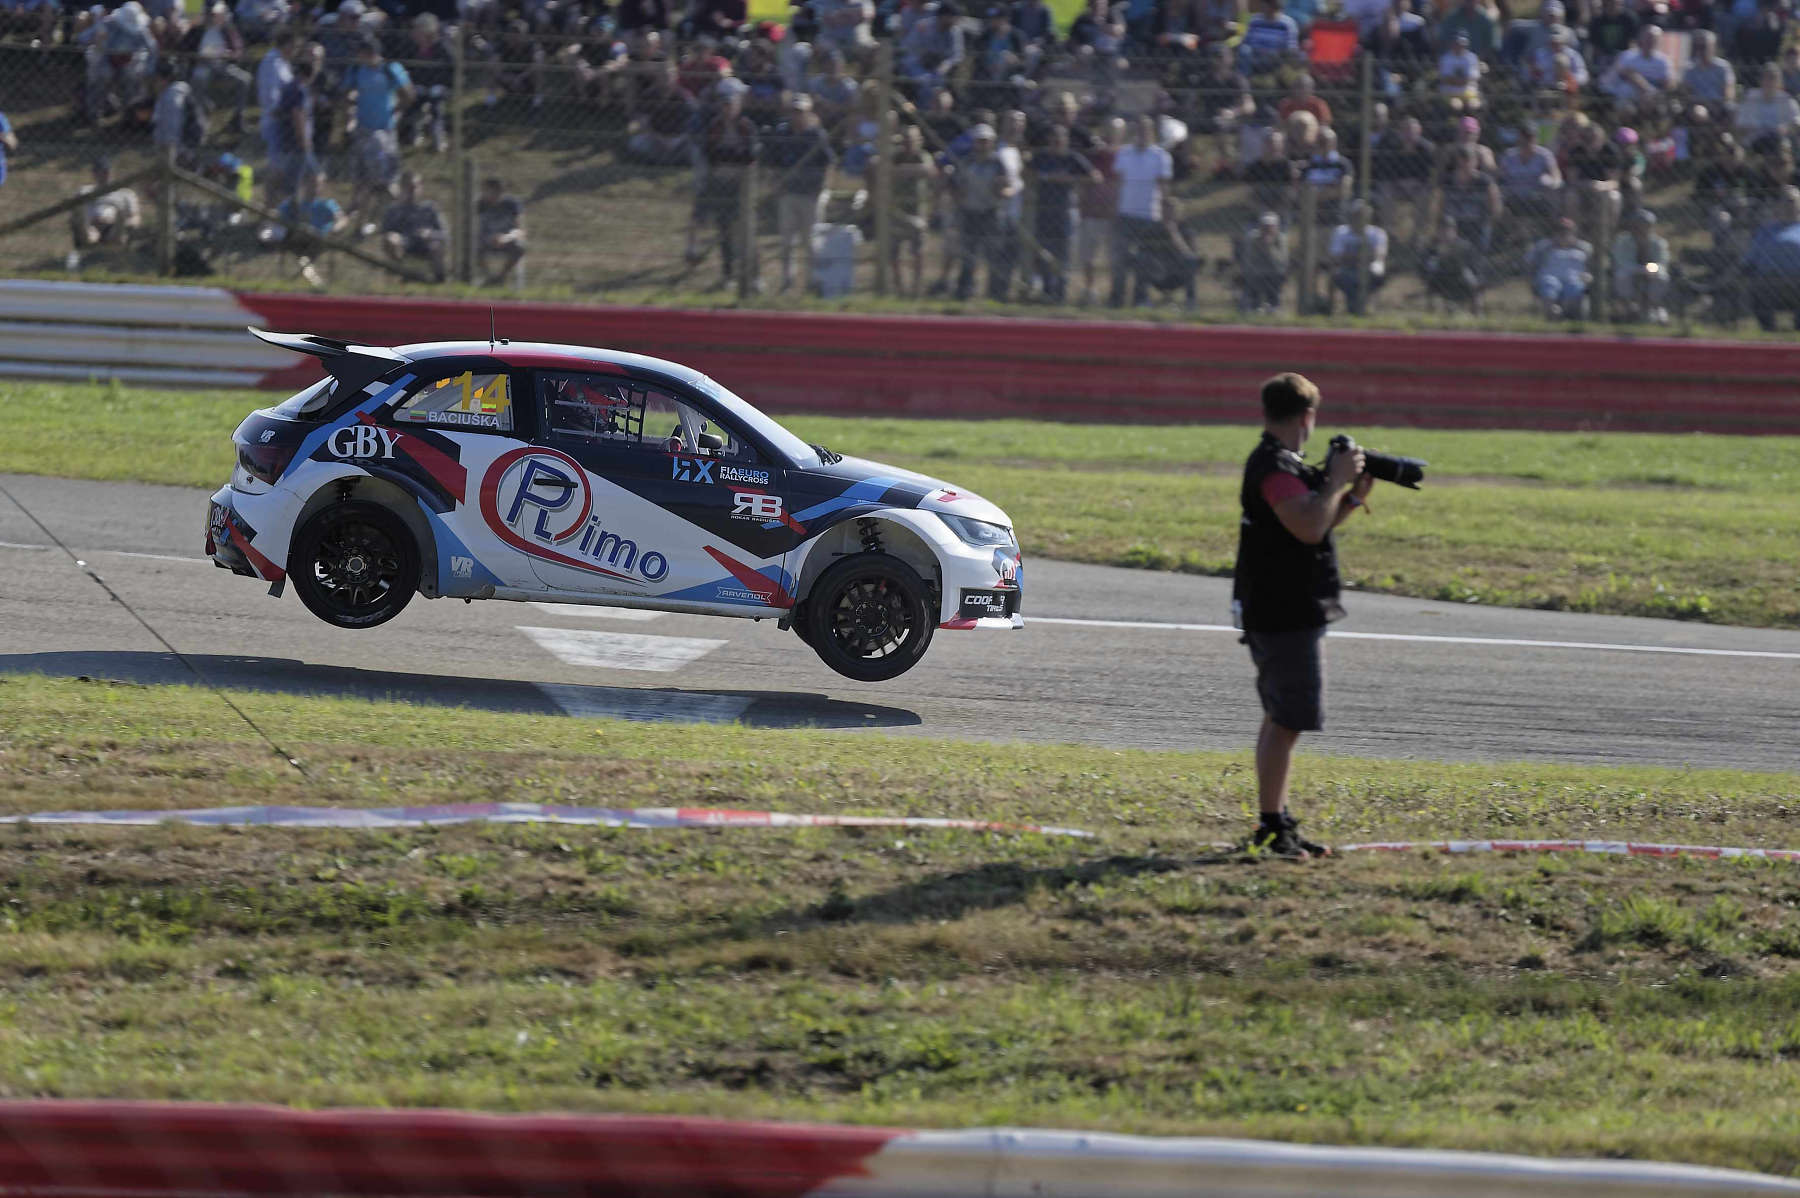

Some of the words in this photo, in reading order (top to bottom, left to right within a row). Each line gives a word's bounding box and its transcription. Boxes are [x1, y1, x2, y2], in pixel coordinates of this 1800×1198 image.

[453, 371, 510, 413] 14
[428, 411, 500, 427] BACIUŠKA
[327, 425, 404, 459] GBY
[720, 472, 769, 485] RALLYCROSS
[721, 589, 767, 600] RAVENOL
